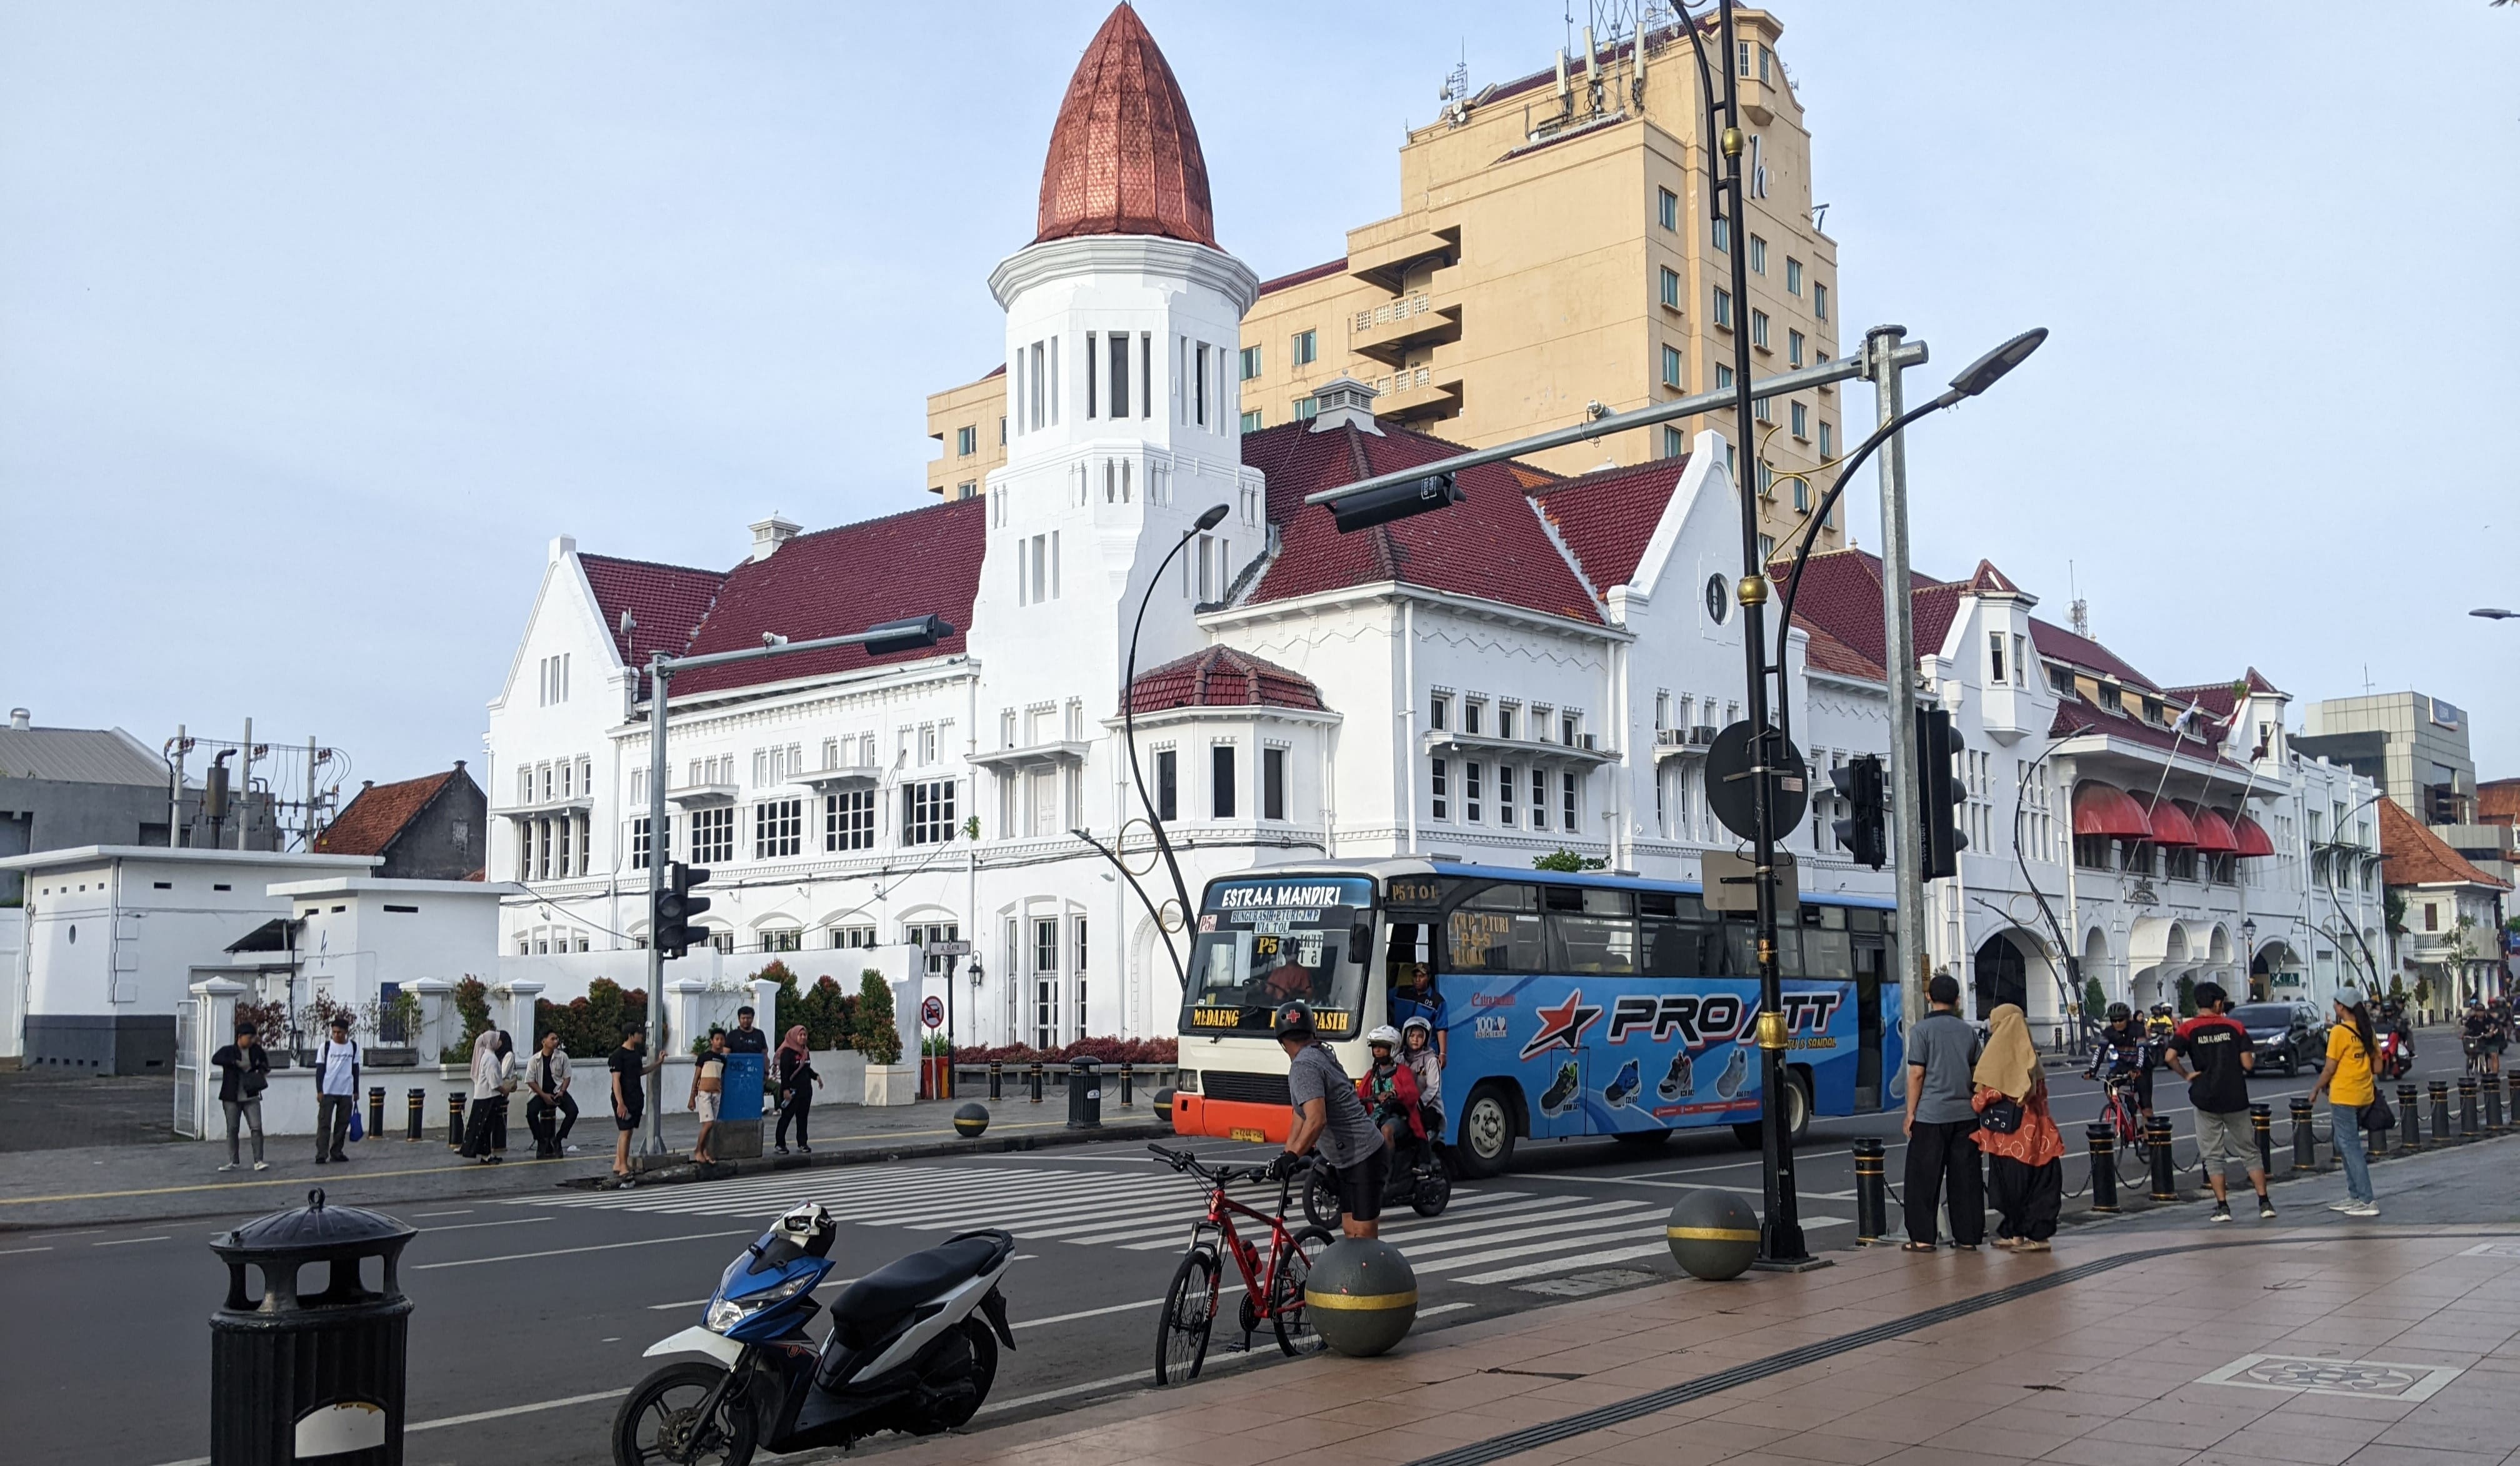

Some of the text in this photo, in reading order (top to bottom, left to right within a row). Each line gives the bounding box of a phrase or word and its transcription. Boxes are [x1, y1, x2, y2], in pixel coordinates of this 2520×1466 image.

[1221, 886, 1341, 907] ESTRAA MANDIRI
[1257, 922, 1288, 933] VIA TOL
[1258, 937, 1278, 954] P5
[1806, 1037, 1837, 1049] SANDAL
[2198, 1035, 2209, 1045] ALDI
